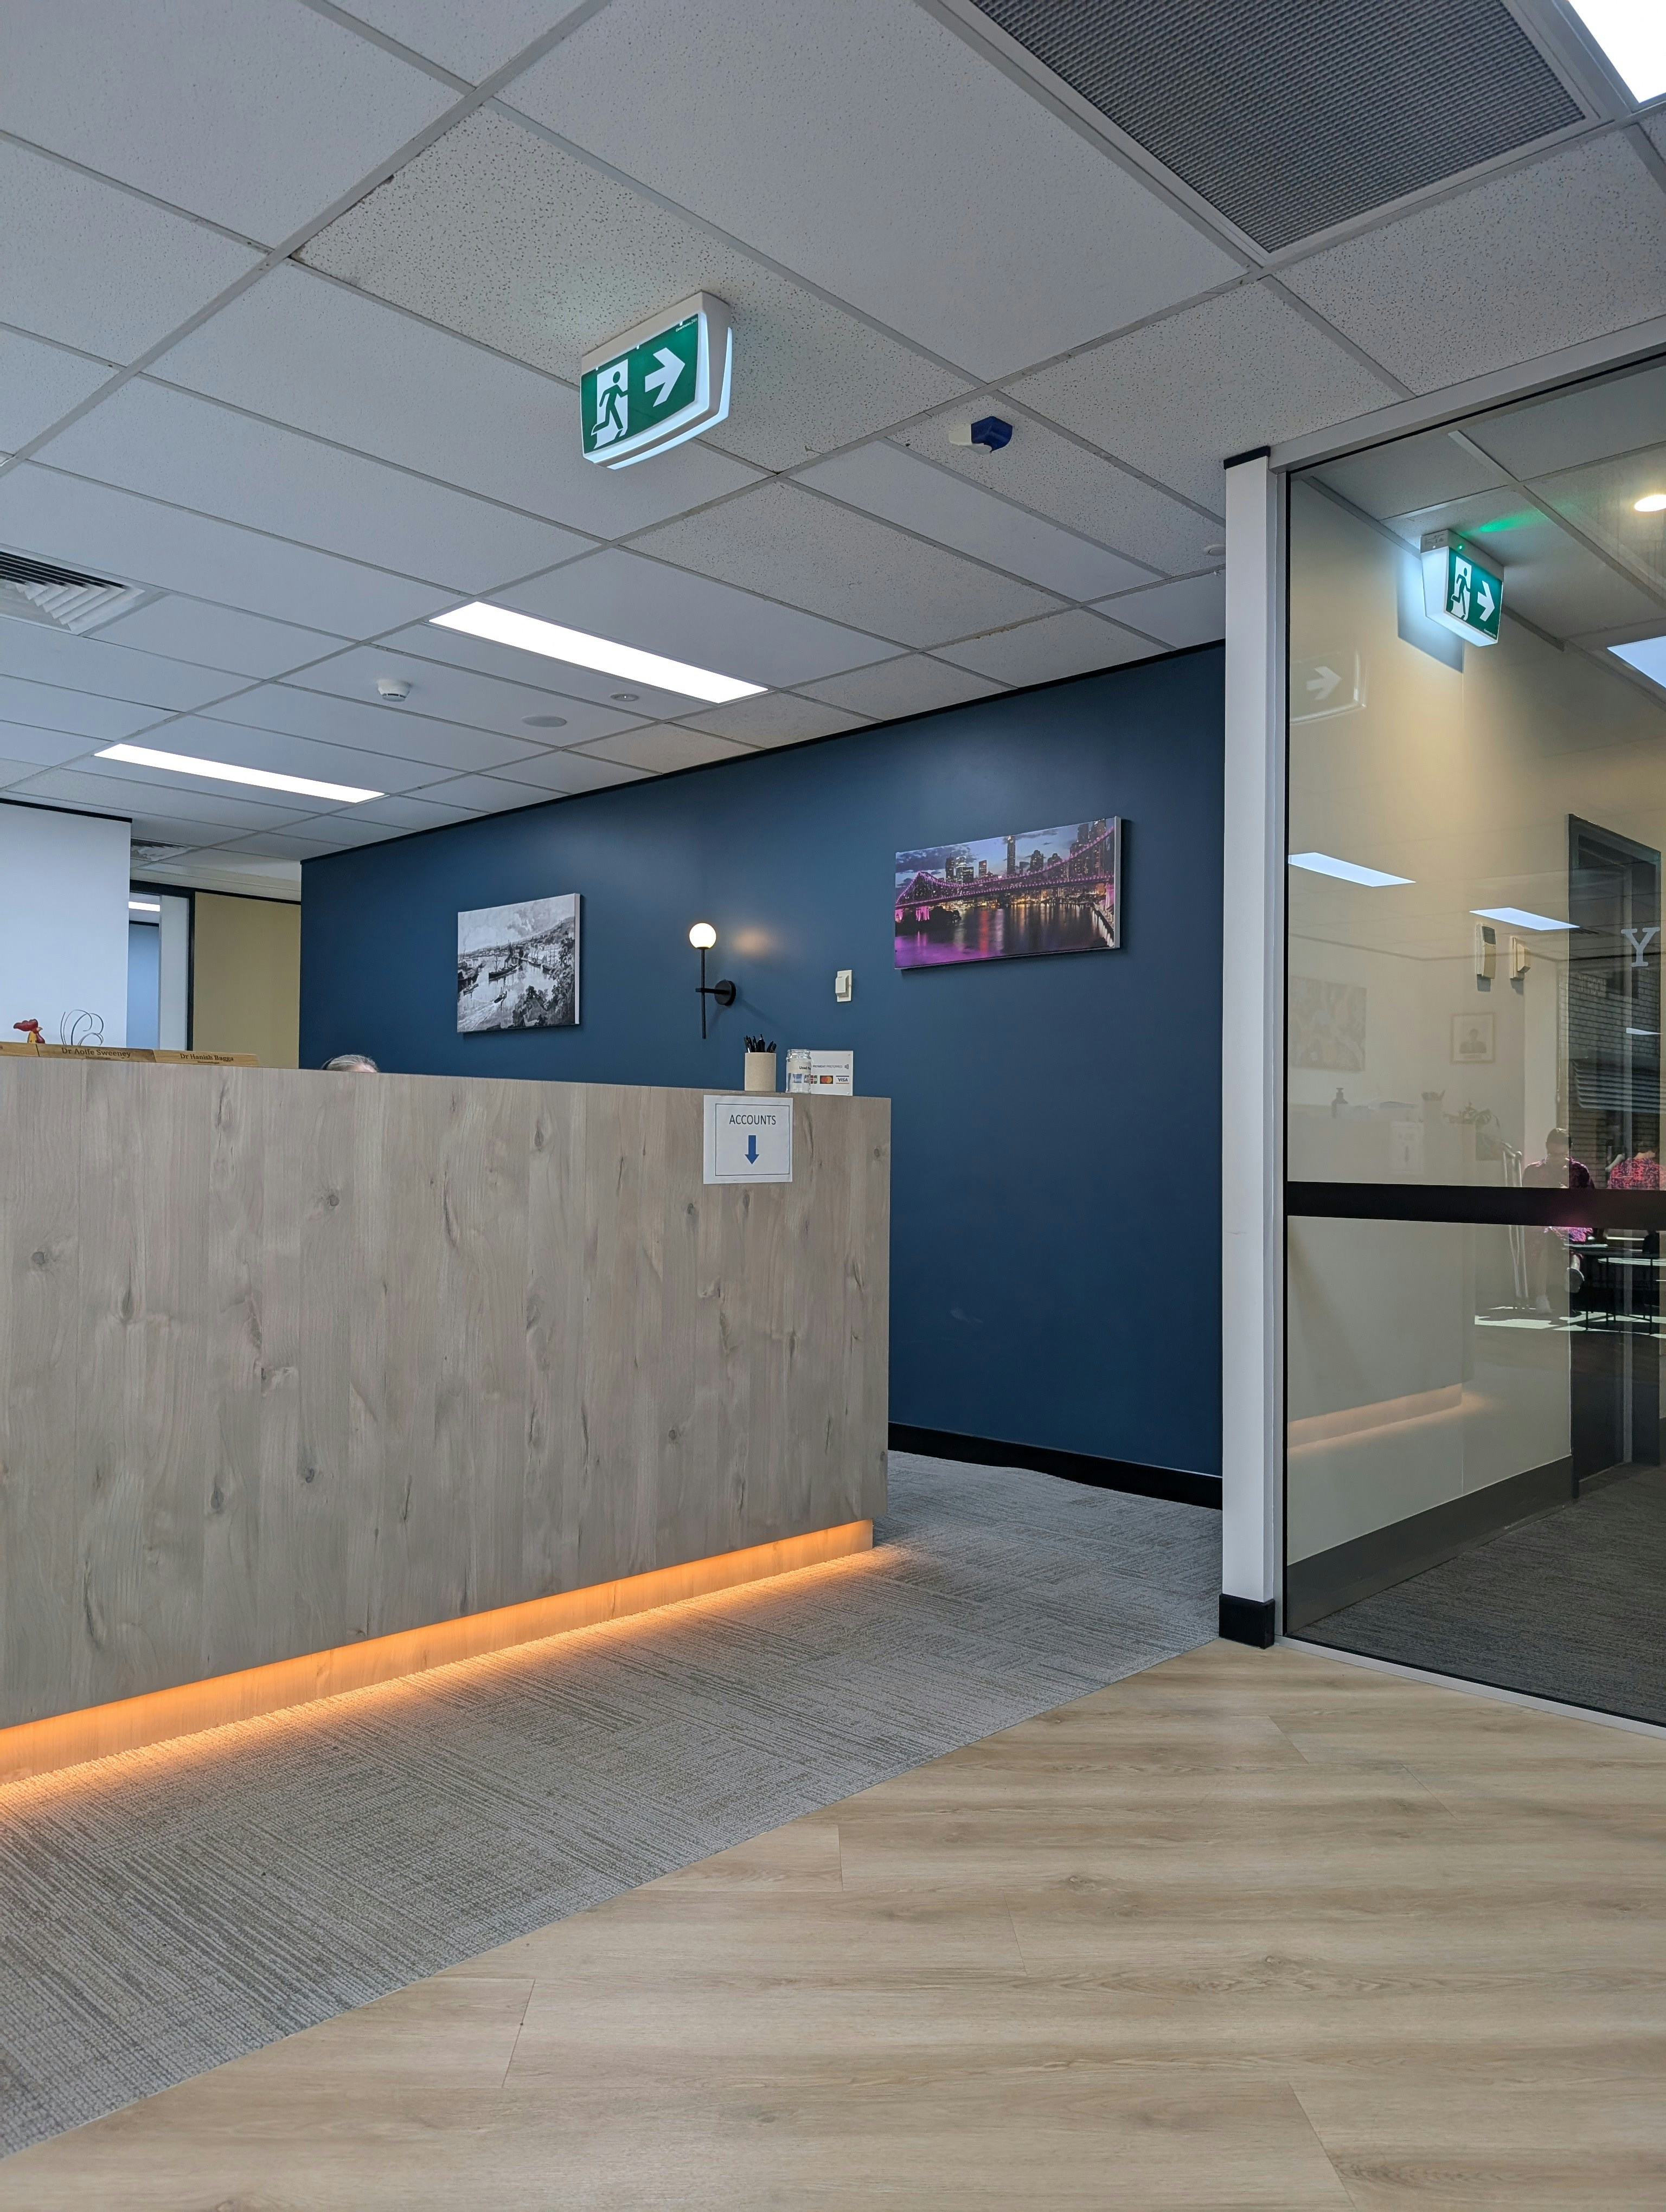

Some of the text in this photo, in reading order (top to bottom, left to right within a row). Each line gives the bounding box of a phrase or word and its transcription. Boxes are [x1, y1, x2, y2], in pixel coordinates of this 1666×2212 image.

[1621, 927, 1660, 967] Y
[97, 1050, 131, 1058] Sweeney
[729, 1114, 777, 1126] ACCOUNTS
